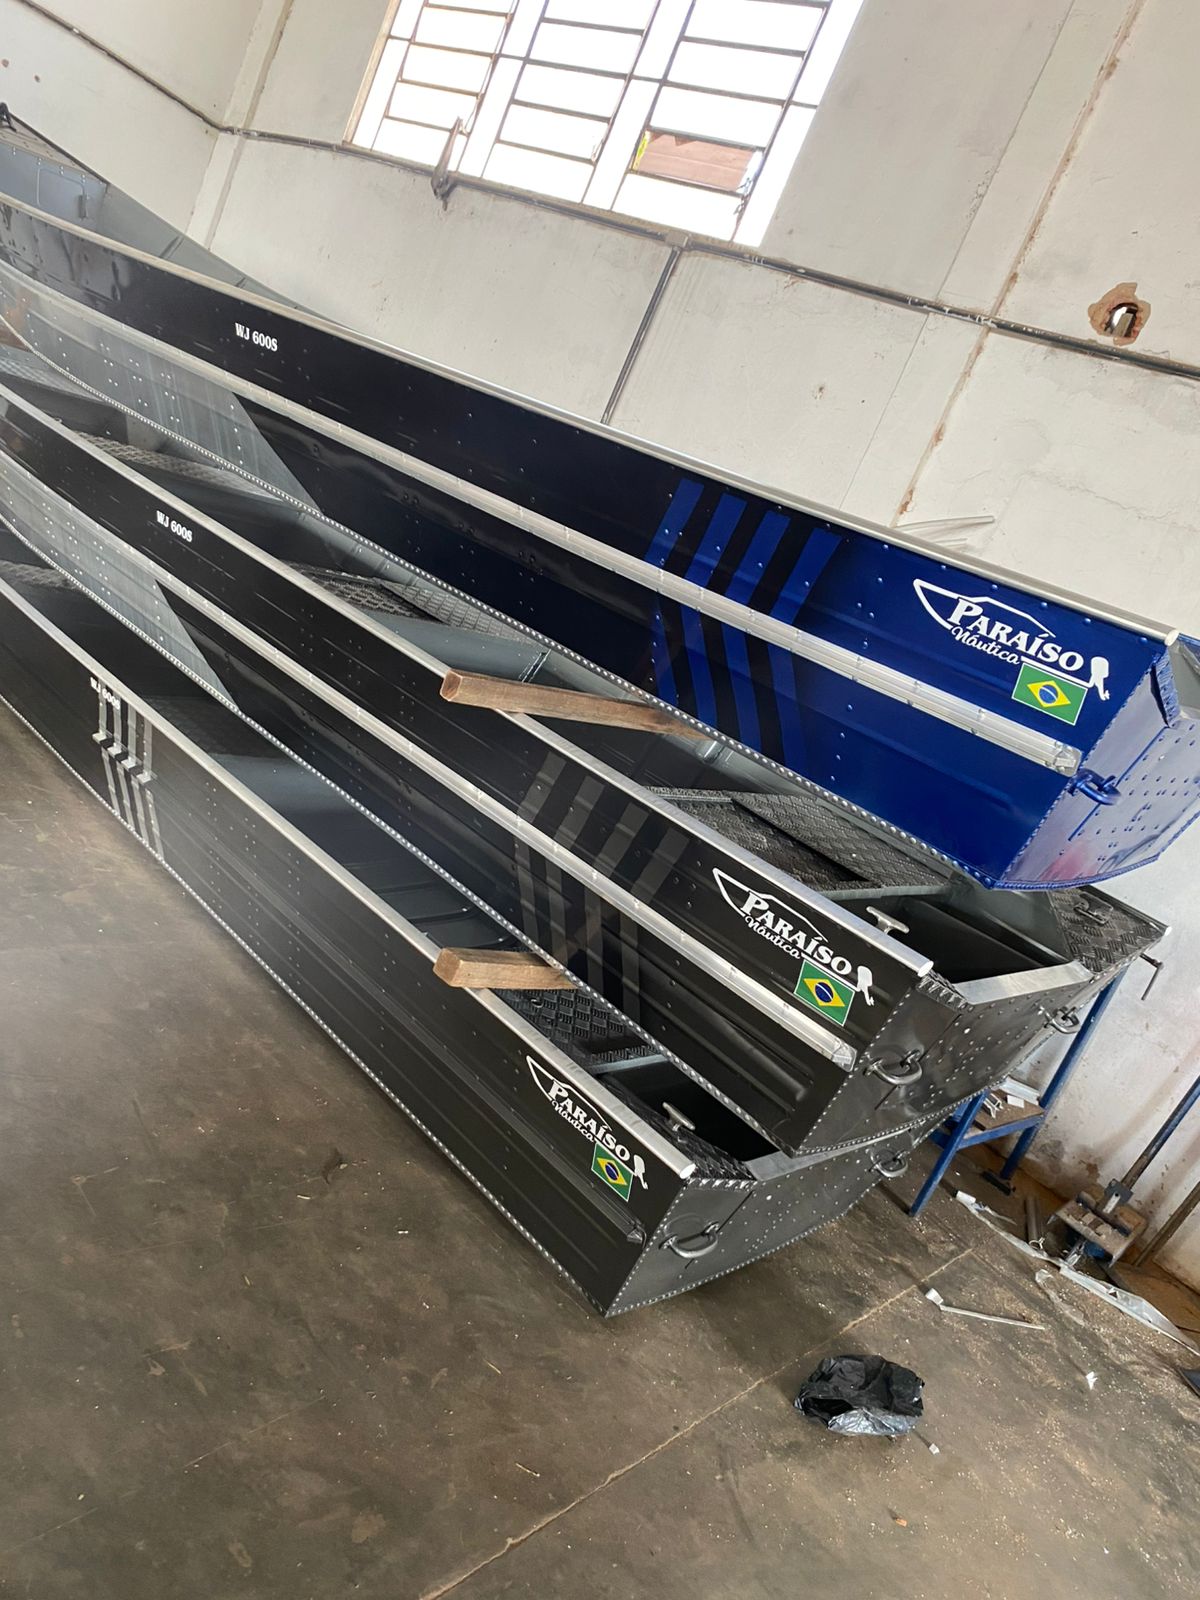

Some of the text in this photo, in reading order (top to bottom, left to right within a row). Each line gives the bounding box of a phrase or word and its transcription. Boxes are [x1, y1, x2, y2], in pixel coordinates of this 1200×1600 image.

[235, 322, 278, 352] WJ 600S
[156, 510, 193, 543] WJ 600S
[947, 598, 1084, 671] PARAÍSO
[951, 626, 1020, 665] Náutica
[740, 892, 852, 975] PARAÍSO
[744, 916, 801, 959] Náutica
